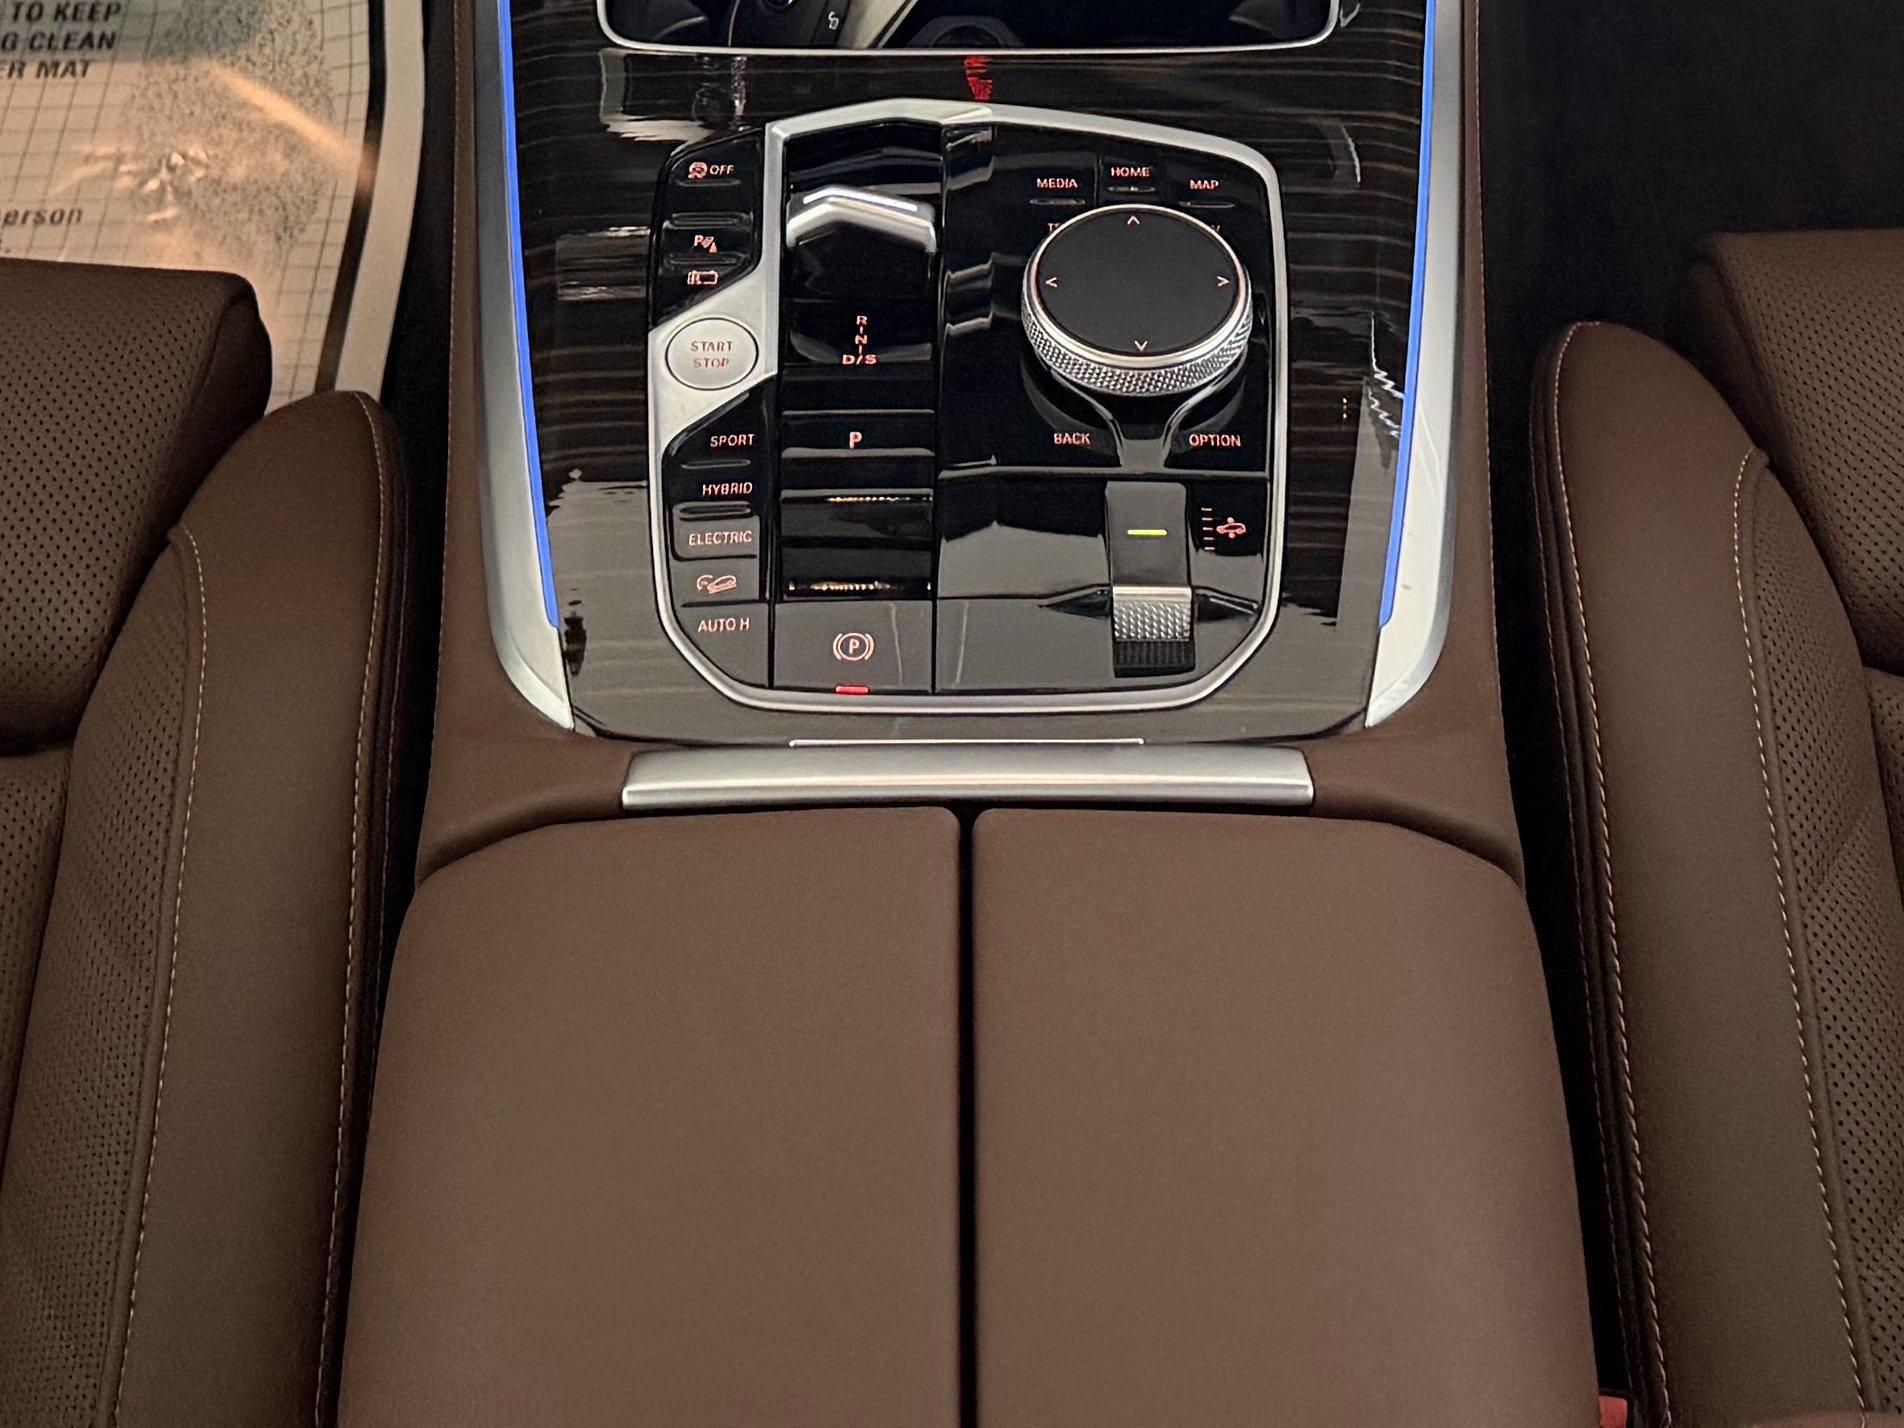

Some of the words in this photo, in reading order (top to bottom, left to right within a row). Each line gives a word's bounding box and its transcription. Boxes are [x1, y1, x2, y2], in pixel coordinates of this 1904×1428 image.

[12, 2, 43, 22] TO
[54, 2, 122, 22] KEEP
[28, 31, 116, 51] CLEAN
[36, 61, 94, 79] MAT
[710, 165, 734, 175] OFF
[1036, 178, 1078, 188] MEDIA
[1111, 167, 1150, 177] HOME
[1190, 180, 1218, 190] MAP
[691, 341, 732, 351] START
[693, 358, 729, 368] STOP
[842, 355, 876, 364] D/S
[710, 434, 756, 447] SPORT
[849, 432, 862, 448] P
[1054, 434, 1090, 444] BACK
[1189, 434, 1241, 446] OPTION
[702, 483, 752, 495] HYBRID
[689, 531, 752, 546] ELECTRIC
[698, 619, 736, 632] AUTO
[740, 618, 749, 630] H
